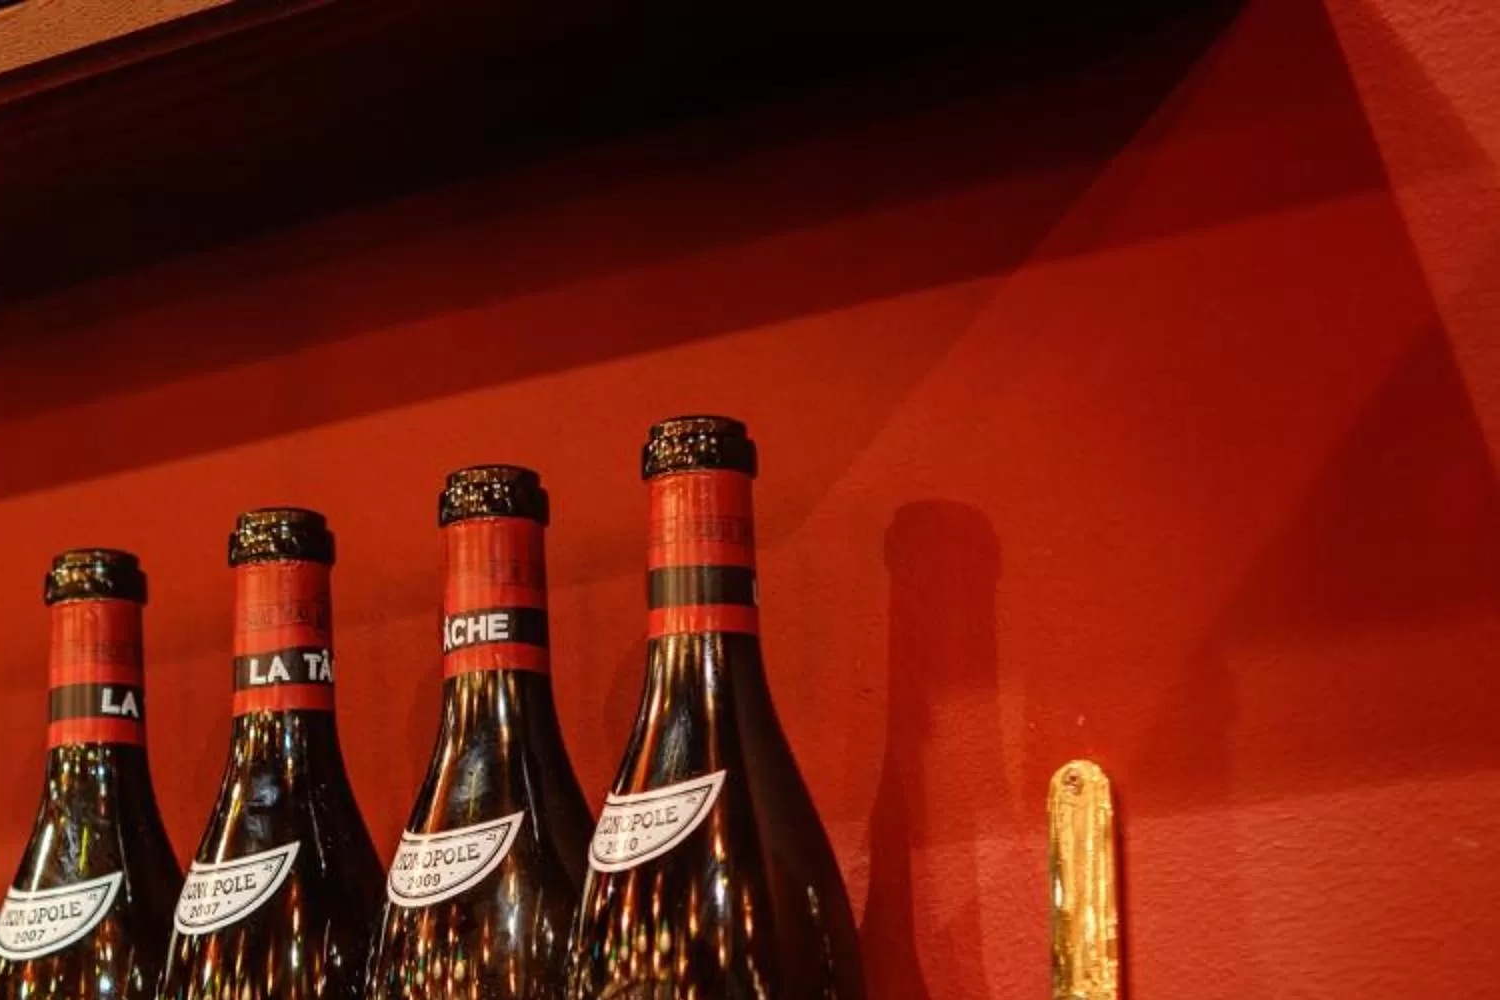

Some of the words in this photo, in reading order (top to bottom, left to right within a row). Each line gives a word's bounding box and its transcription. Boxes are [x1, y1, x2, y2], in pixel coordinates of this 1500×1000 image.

[443, 614, 509, 653] ÂCHE
[249, 655, 290, 685] LA
[101, 687, 139, 718] LA
[604, 837, 638, 855] 20
[189, 902, 220, 919] 2007
